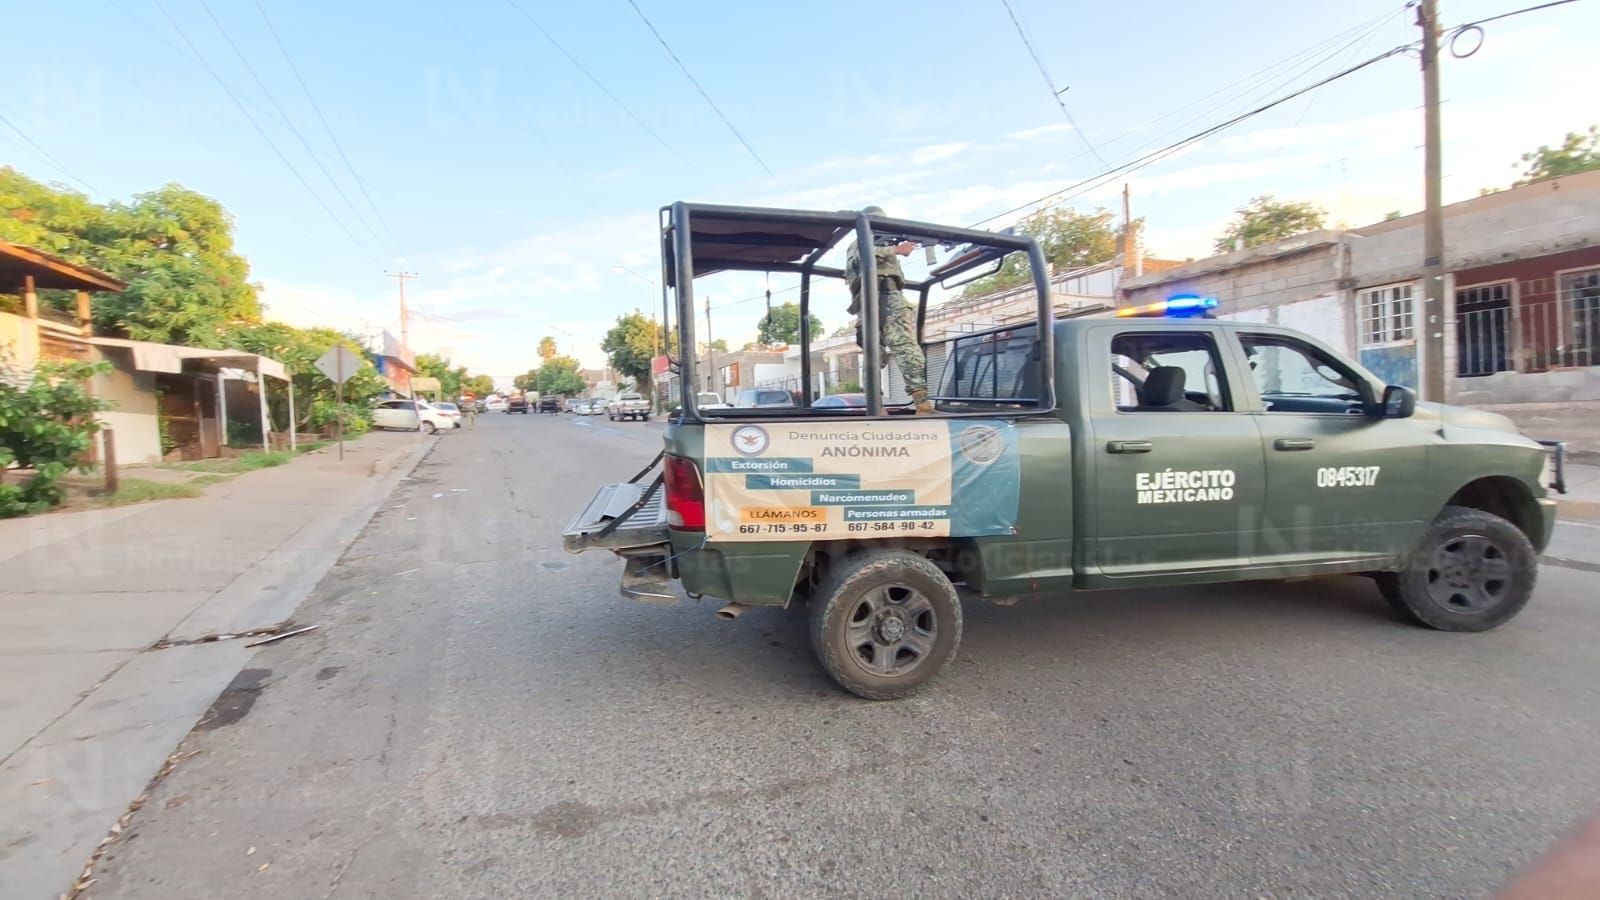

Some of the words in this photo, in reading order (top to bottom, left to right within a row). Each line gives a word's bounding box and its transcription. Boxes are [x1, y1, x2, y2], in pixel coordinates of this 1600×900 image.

[788, 431, 859, 441] Denuncia
[861, 431, 938, 441] Ciudadana
[821, 444, 910, 457] ANÓNIMA
[731, 460, 788, 470] Extorsión
[1135, 468, 1236, 490] EJÉRCITO
[1317, 466, 1380, 487] 0845317
[770, 477, 837, 487] Homicidios
[819, 492, 907, 503] Narcomenudeo
[1137, 488, 1234, 504] MEXICANO
[749, 509, 817, 519] LLÁMANOS
[847, 509, 898, 518] Personas
[900, 508, 947, 517] armadas
